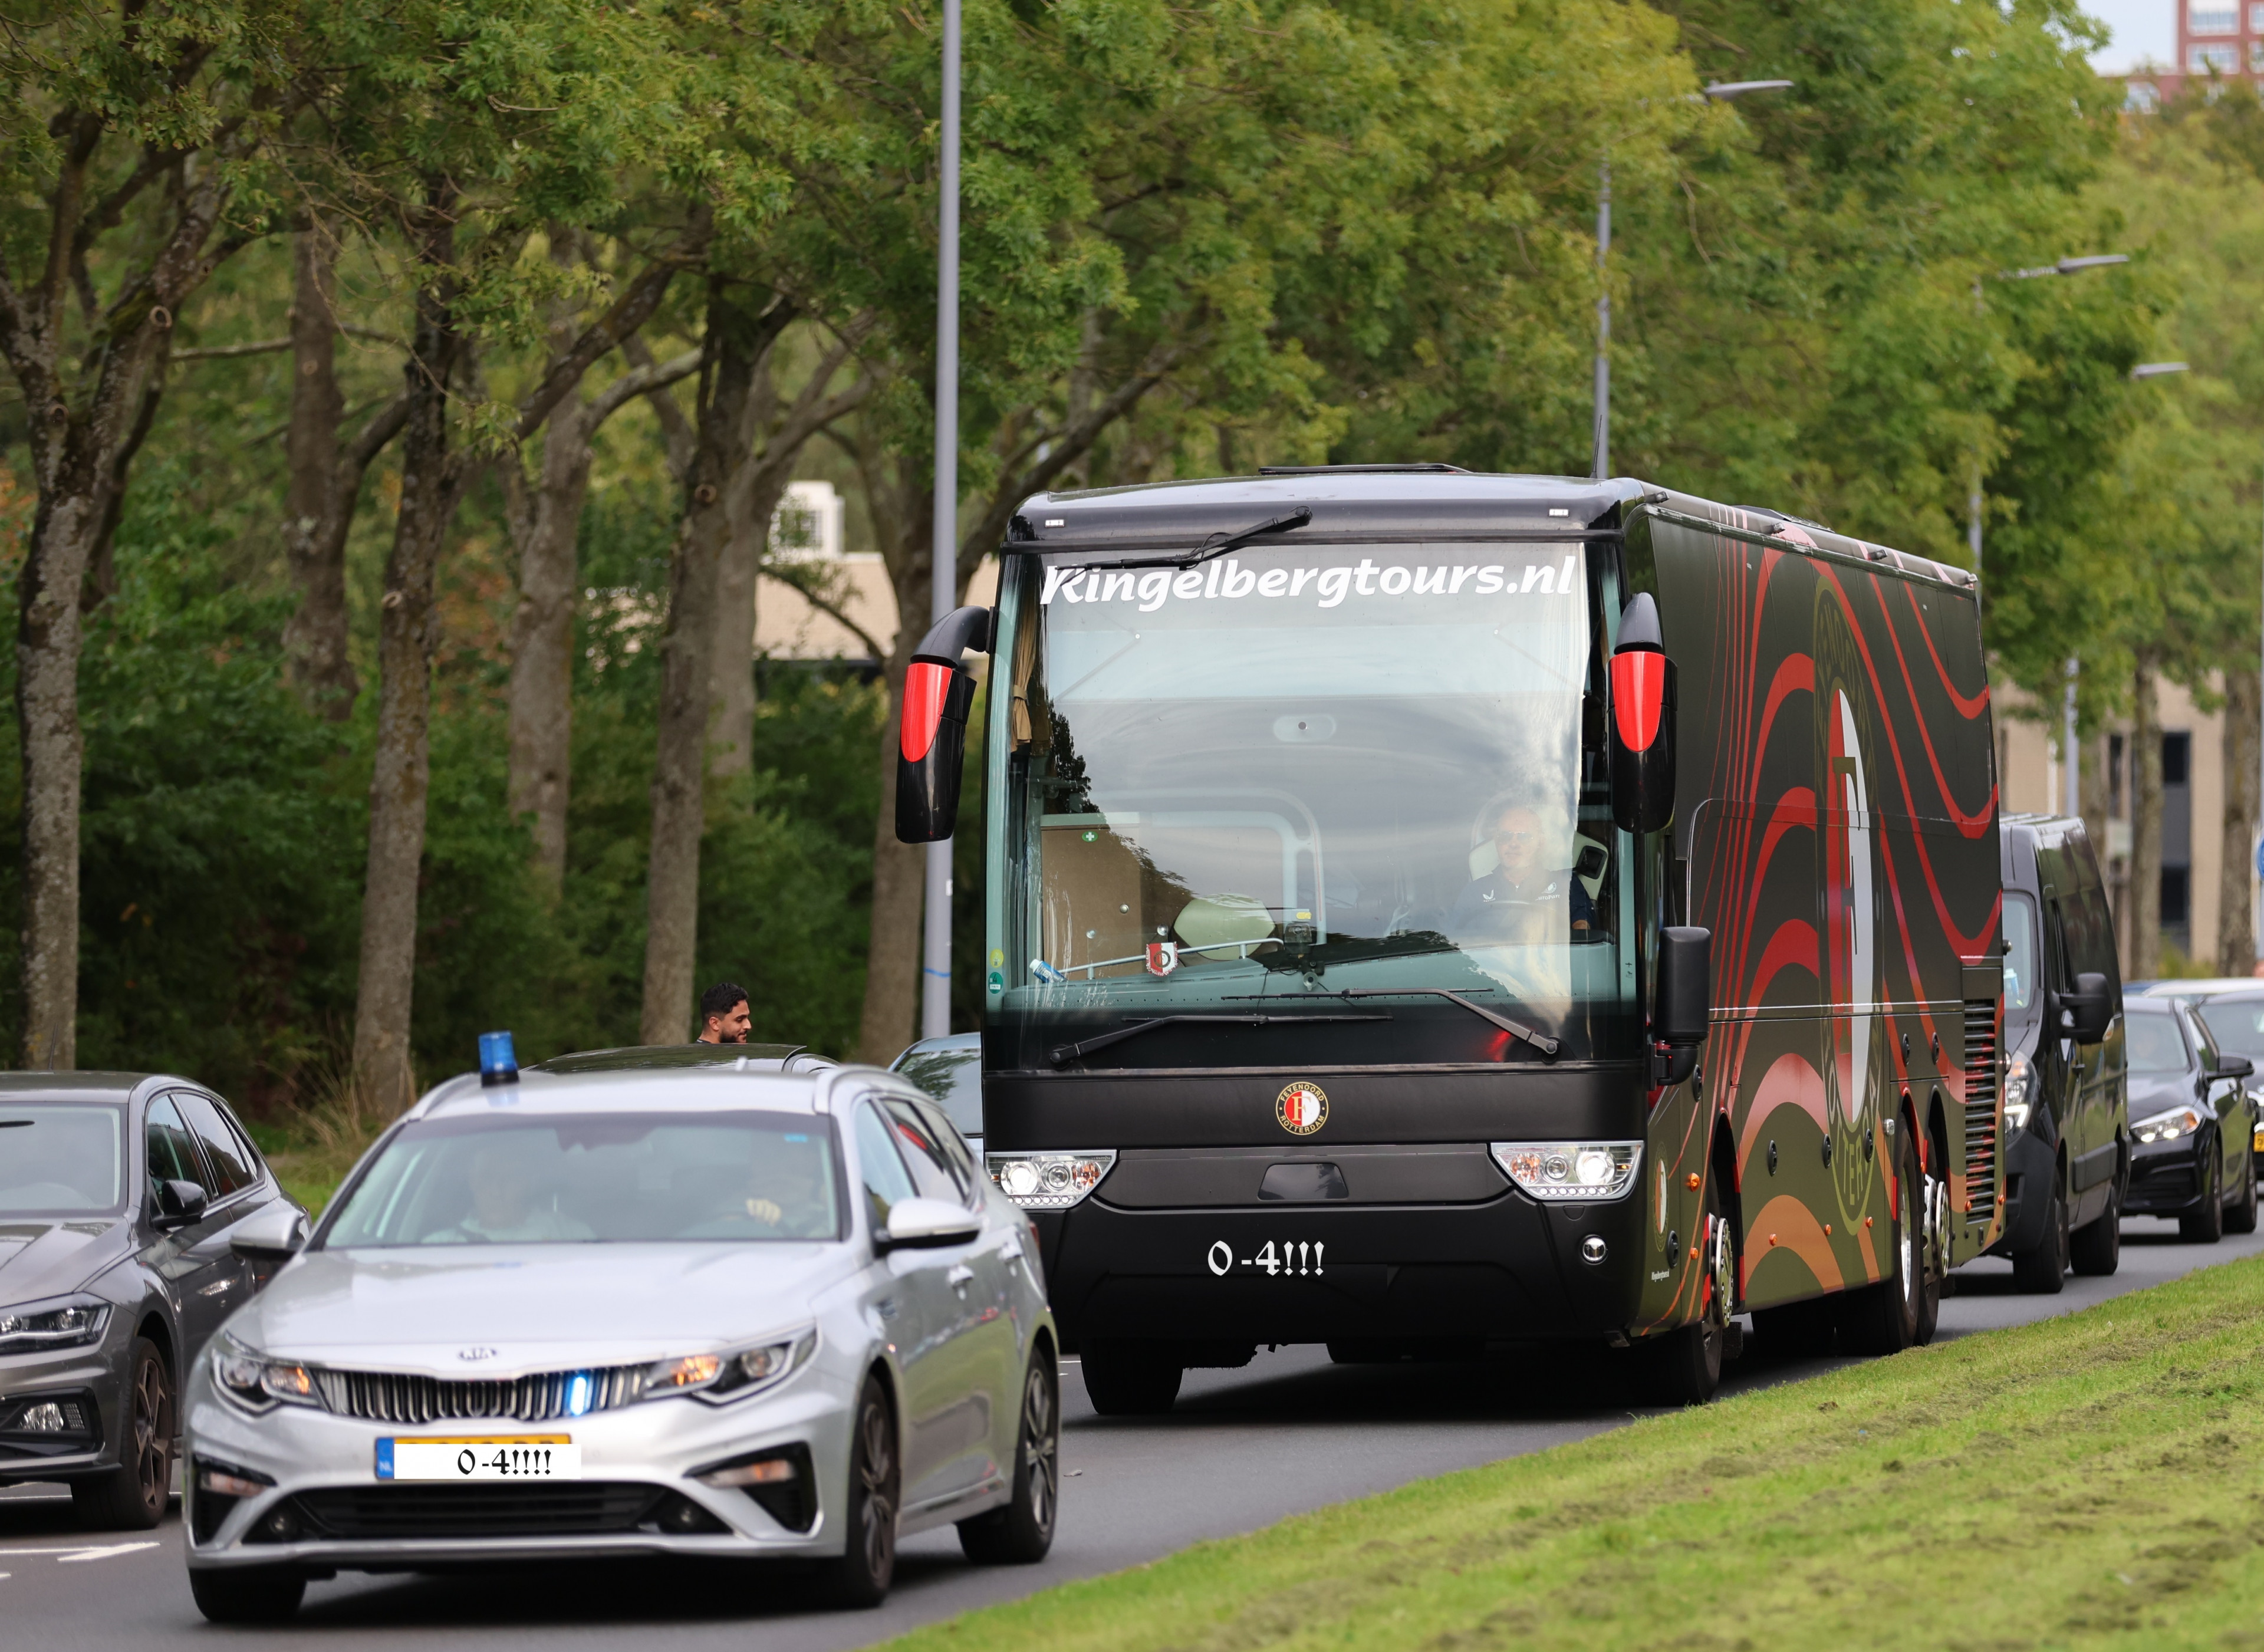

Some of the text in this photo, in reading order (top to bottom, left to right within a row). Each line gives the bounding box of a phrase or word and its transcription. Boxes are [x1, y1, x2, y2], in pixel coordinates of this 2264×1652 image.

[1039, 555, 1576, 612] Kingelbergtours.nl
[1280, 1084, 1324, 1102] FEYENOORD
[1291, 1095, 1311, 1121] F
[1280, 1115, 1325, 1133] ROTTERDAM
